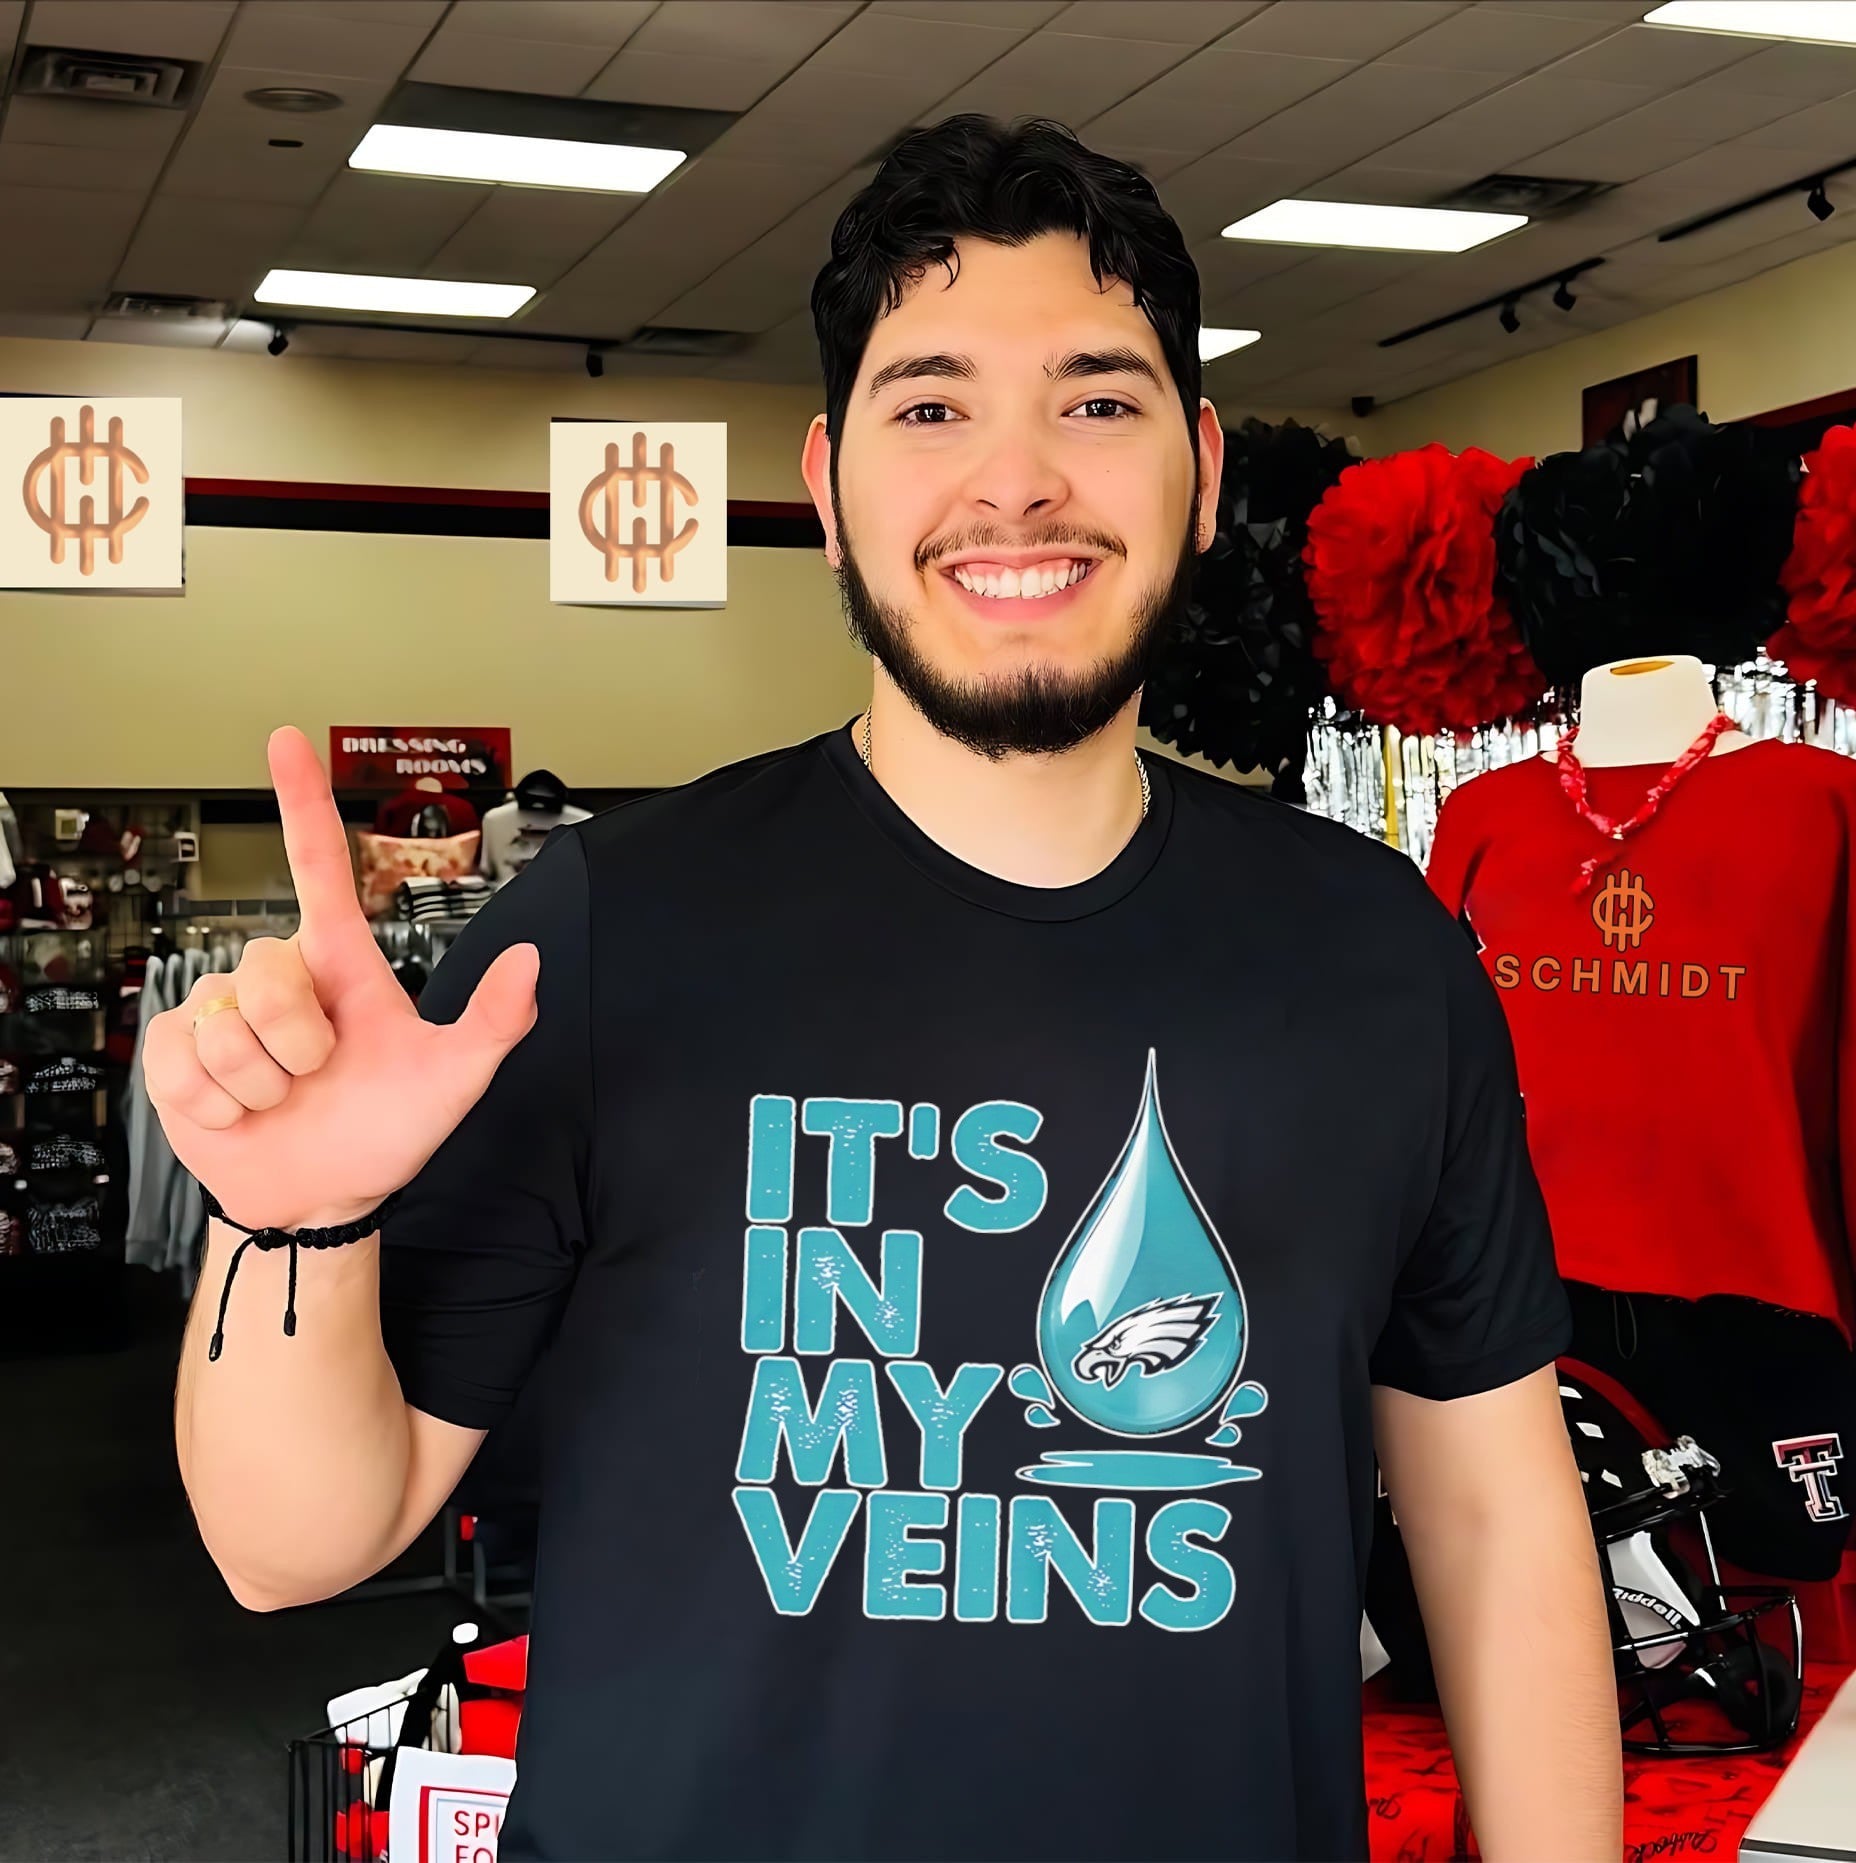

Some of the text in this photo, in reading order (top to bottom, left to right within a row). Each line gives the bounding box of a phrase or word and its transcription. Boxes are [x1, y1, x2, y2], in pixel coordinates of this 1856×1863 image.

[342, 737, 466, 753] DRESSING
[396, 758, 486, 775] ROOMS
[1494, 953, 1746, 1000] SCHMIDT
[746, 1094, 1048, 1233] IT'S
[741, 1225, 923, 1357] IN
[735, 1356, 1004, 1490] MY
[732, 1486, 1236, 1632] VEINS
